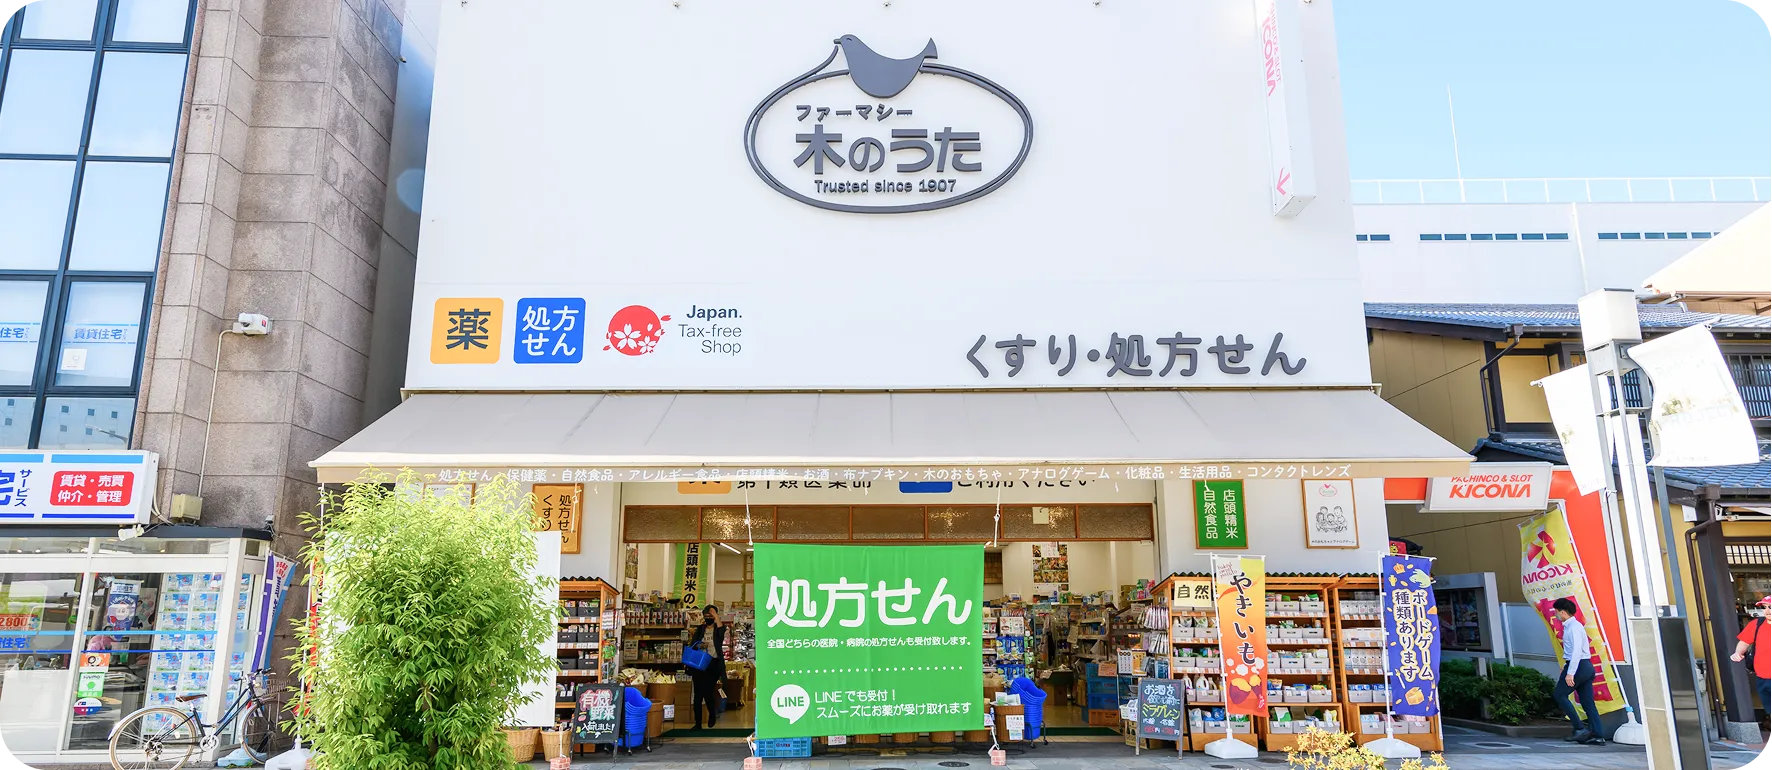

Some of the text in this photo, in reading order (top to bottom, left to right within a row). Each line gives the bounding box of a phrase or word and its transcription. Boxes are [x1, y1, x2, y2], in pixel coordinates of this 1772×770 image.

[796, 103, 913, 122] ファーマシー
[793, 124, 982, 175] 木のうた
[814, 179, 957, 193] Trusted since 1907
[522, 305, 580, 332] 処方
[686, 304, 742, 320] Japan.
[445, 308, 491, 350] 薬
[678, 323, 742, 338] Tax-free
[522, 332, 577, 357] せん
[700, 339, 741, 357] Shop
[966, 331, 1306, 378] くすり・処方せん
[60, 474, 125, 488] 賃貸・売買
[1509, 474, 1534, 482] SLOT
[14, 469, 32, 507] サービス
[58, 490, 122, 503] 仲介・管理
[1449, 484, 1530, 499] KICONA
[542, 494, 554, 532] くすり
[558, 494, 572, 544] 処方せん
[1203, 490, 1218, 540] 自然食品
[1223, 489, 1239, 539] 店頭精米
[684, 542, 700, 609] 店頭精米の
[1178, 584, 1210, 599] 自然
[766, 576, 973, 628] 処方せん
[1230, 572, 1256, 665] やきいも
[766, 636, 972, 649] 全国どちらの医院・病院の処方せんも受付致します。
[1394, 590, 1418, 680] 種類あります
[1412, 591, 1434, 680] ボードゲーム
[814, 690, 842, 704] LINE
[1144, 684, 1176, 696] お酒を
[582, 690, 611, 710] 有機
[776, 696, 804, 708] LINE
[590, 704, 616, 720] 野菜
[816, 702, 972, 719] スムーズにお薬が受け取れます
[1142, 703, 1180, 720] ミラグレーン
